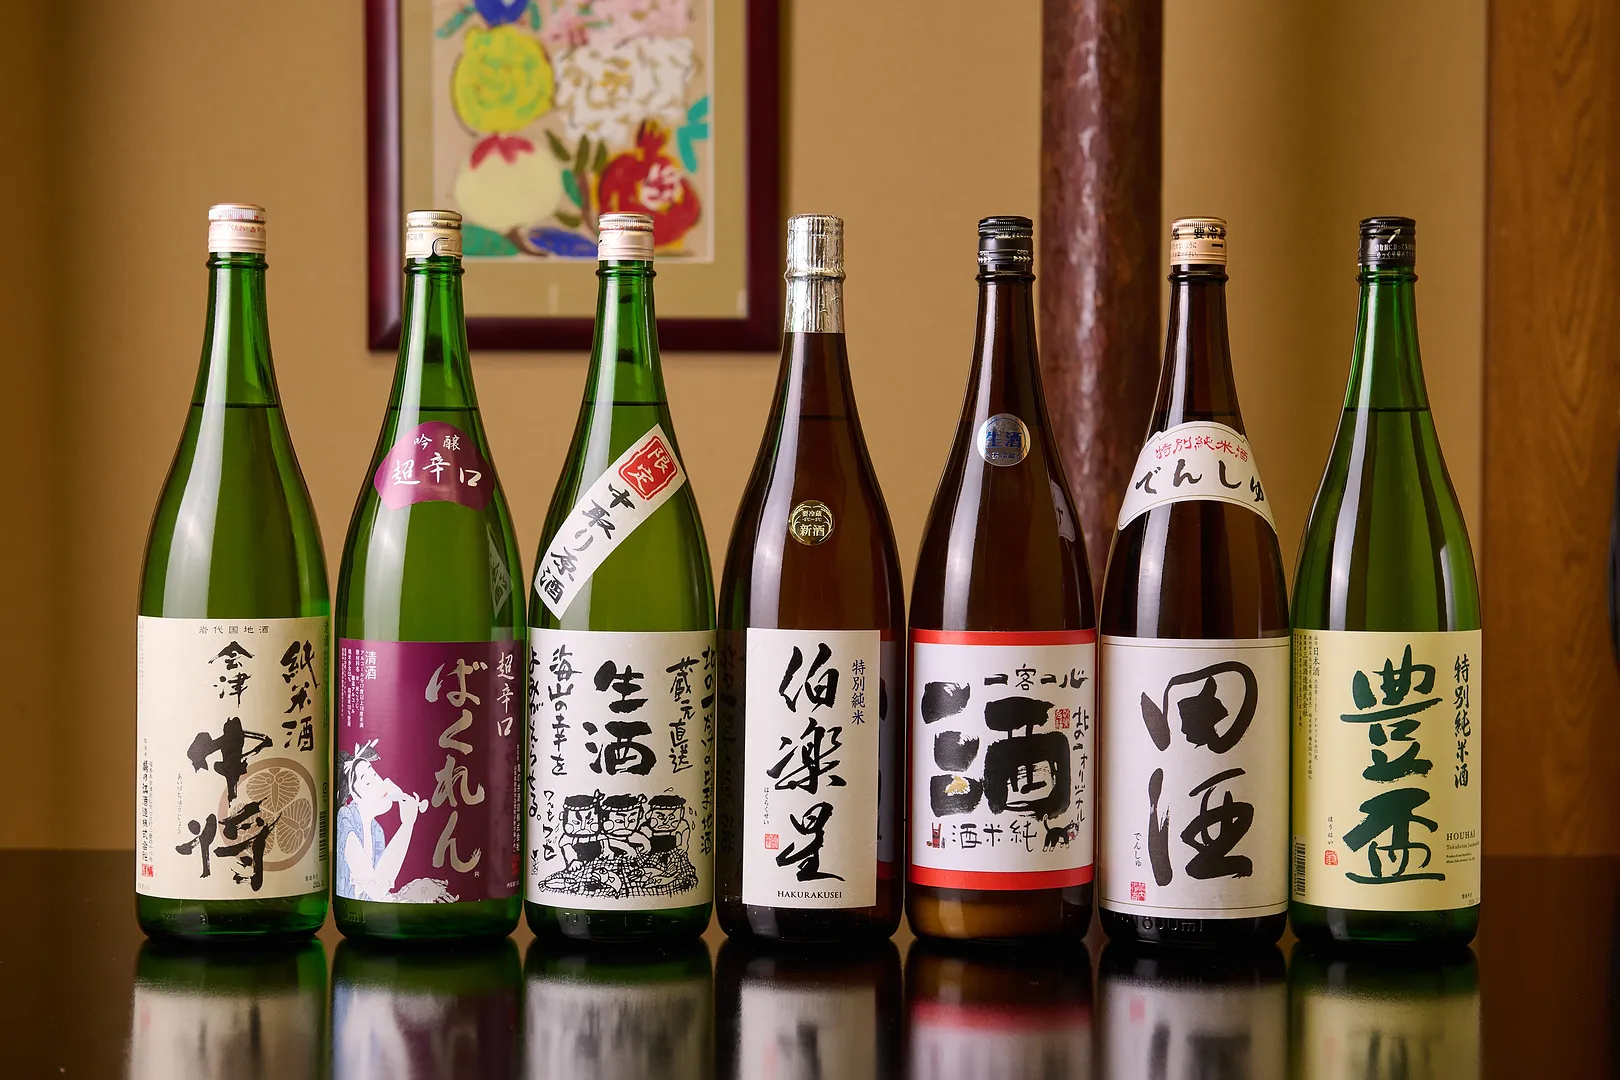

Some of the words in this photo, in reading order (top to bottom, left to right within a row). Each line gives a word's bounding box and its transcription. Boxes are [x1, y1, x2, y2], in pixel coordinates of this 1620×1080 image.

[413, 434, 461, 451] 吟醸
[986, 428, 1022, 449] 生酒
[1155, 436, 1248, 463] 特別純米酒
[391, 452, 482, 487] 超辛口
[627, 447, 671, 493] 限定
[1135, 459, 1264, 502] でんしゅ
[539, 483, 635, 604] 中取り原酒
[800, 524, 825, 537] 新酒
[199, 625, 269, 635] 岩代国地酒
[365, 651, 377, 680] 清酒
[851, 659, 866, 725] 特別純米
[280, 640, 320, 752] 純米酒
[496, 651, 515, 738] 超辛口
[548, 644, 583, 776] 海山の幸を
[582, 660, 657, 776] 生酒
[666, 656, 699, 774] 蔵元直送
[1453, 654, 1472, 788] 特別純米酒
[425, 659, 488, 873] ばくれん
[766, 643, 847, 882] 伯楽星
[921, 681, 1072, 822] 酒
[1140, 660, 1258, 887] 田酒
[1133, 832, 1142, 867] でんしゅ
[1446, 830, 1476, 841] HOUHAI
[777, 890, 842, 899] HAKURAKUSEI
